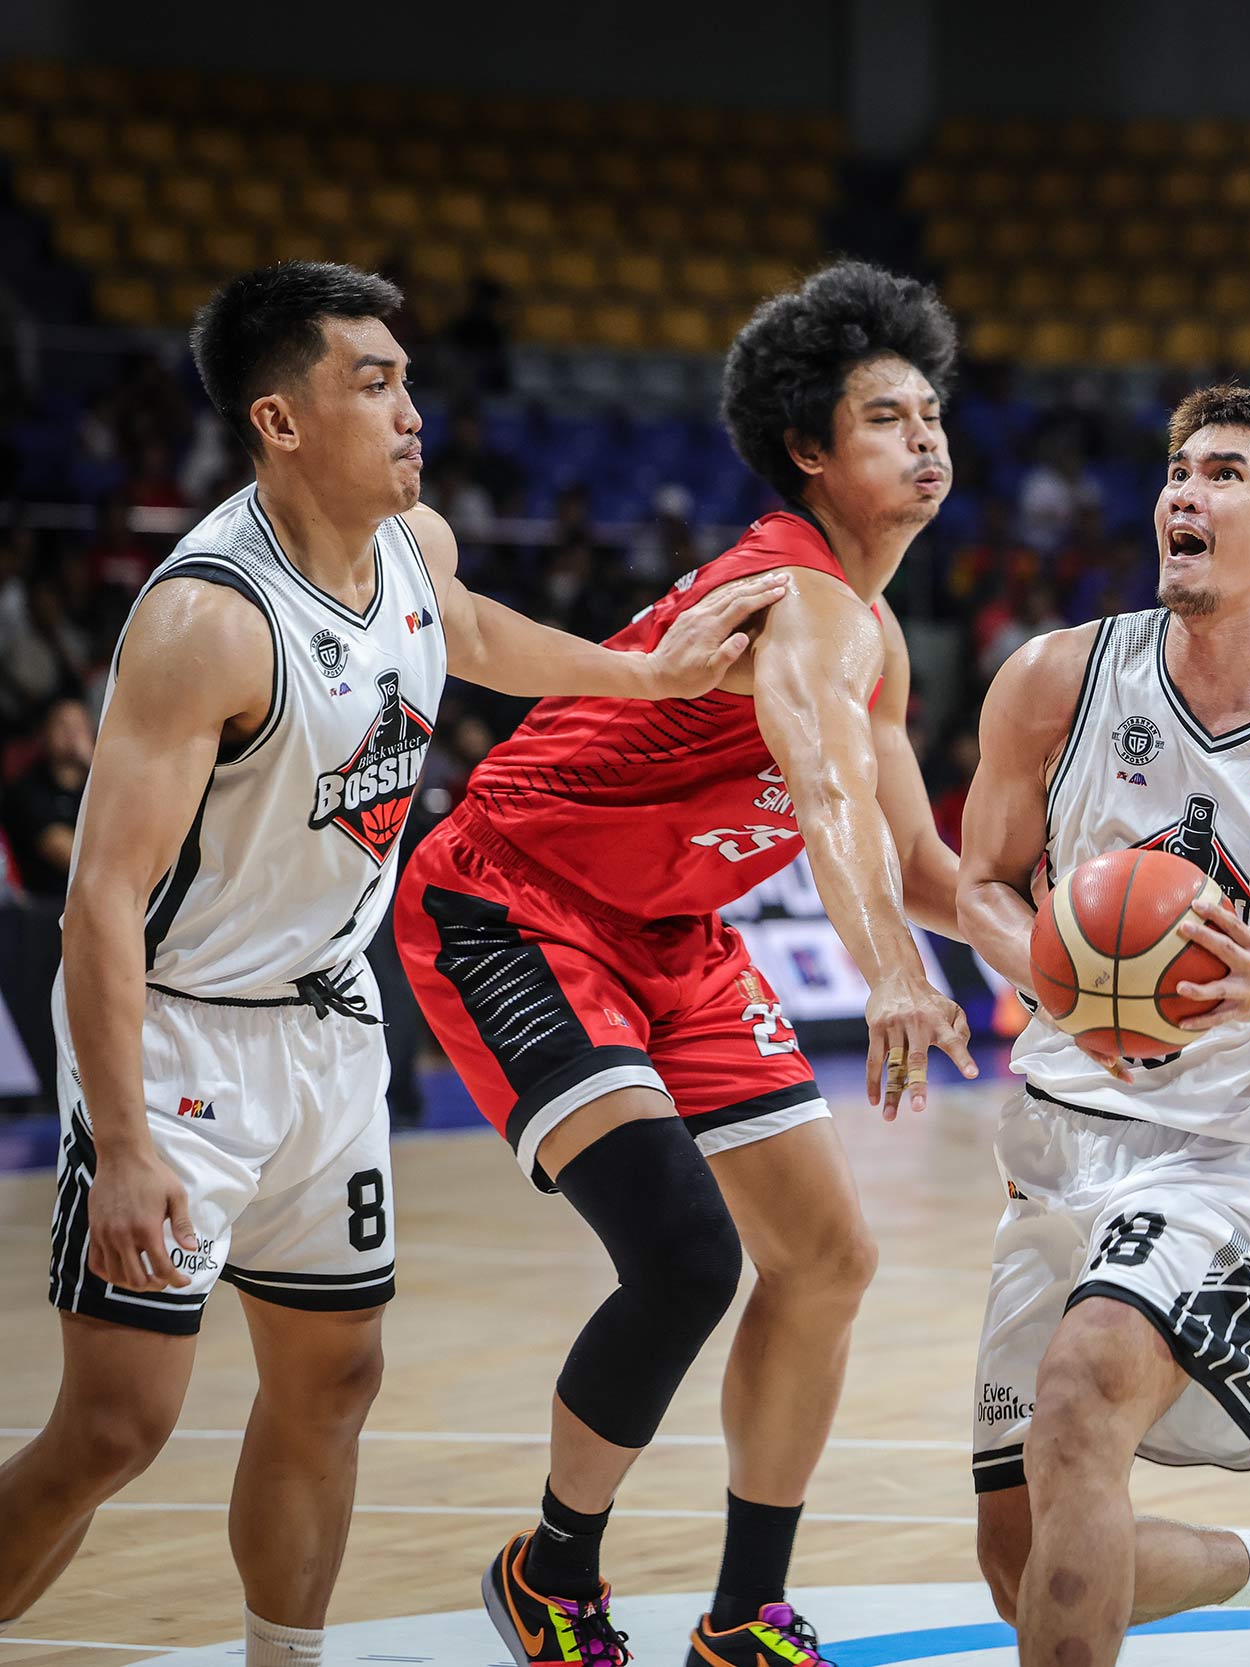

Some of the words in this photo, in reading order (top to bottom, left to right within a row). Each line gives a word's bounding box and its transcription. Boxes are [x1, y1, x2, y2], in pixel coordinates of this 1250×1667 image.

[357, 734, 422, 772] Blackwater
[1121, 751, 1150, 765] SPORTS
[313, 742, 429, 822] BOSSIN
[176, 1096, 217, 1120] PBA
[346, 1167, 387, 1252] 8
[193, 1233, 215, 1254] ver
[983, 1381, 1014, 1403] Ever
